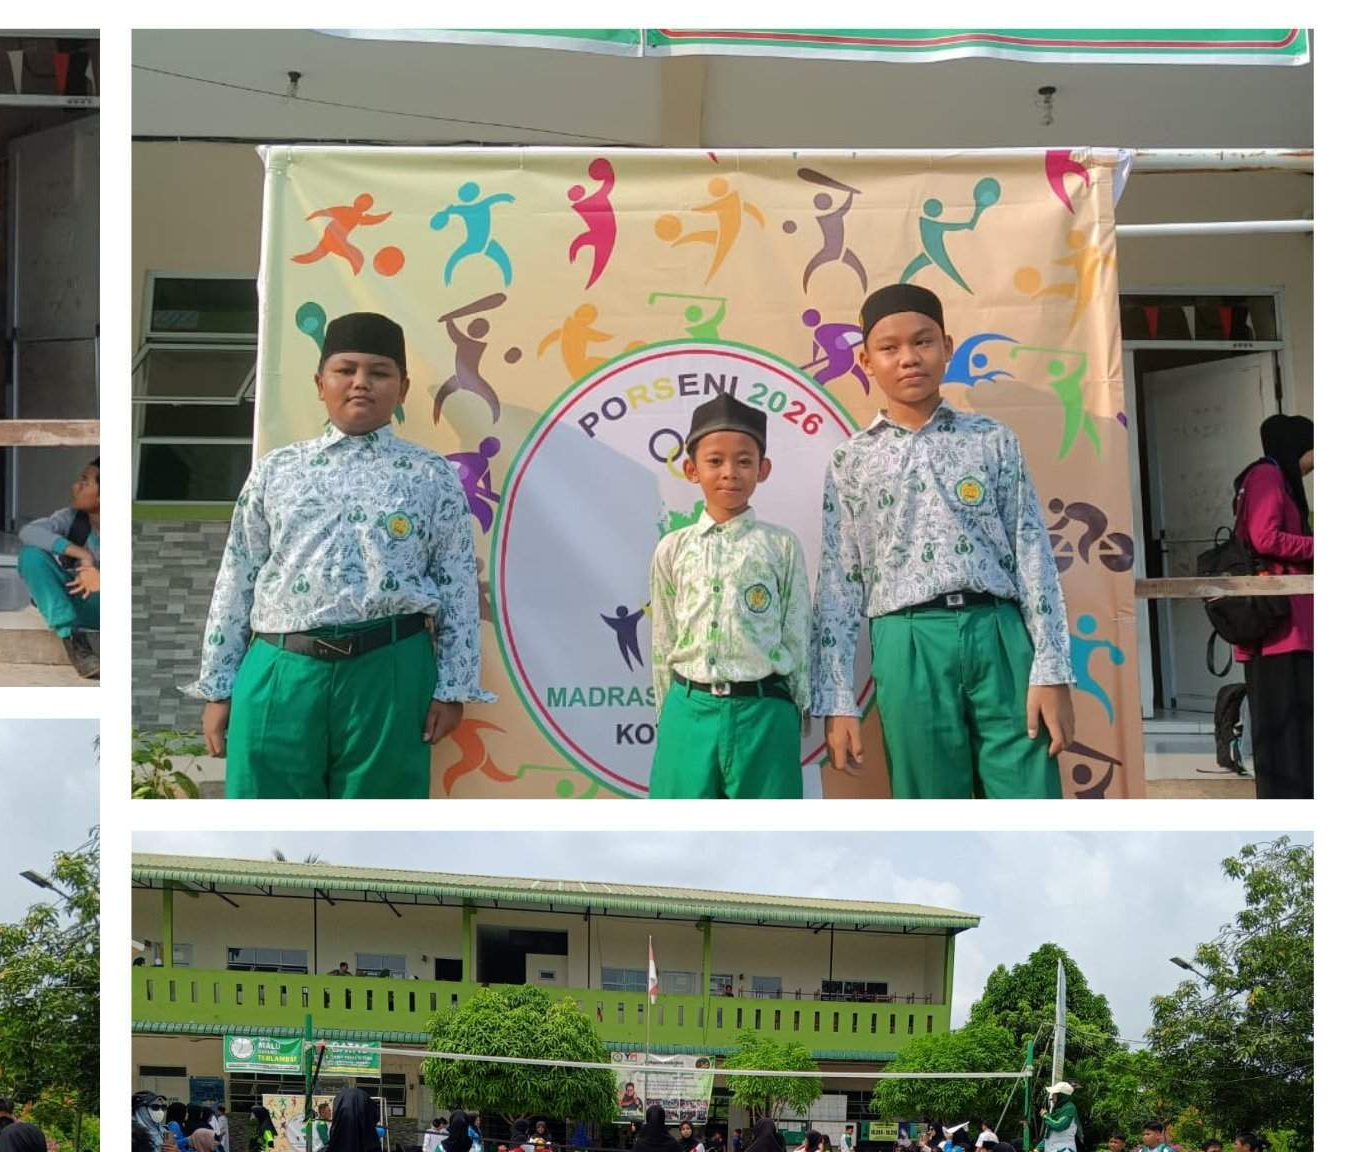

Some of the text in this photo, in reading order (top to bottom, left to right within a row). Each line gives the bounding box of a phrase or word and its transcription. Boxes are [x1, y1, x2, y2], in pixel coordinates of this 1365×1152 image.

[577, 372, 824, 438] PORSENI 2026
[546, 686, 658, 708] MADRAS
